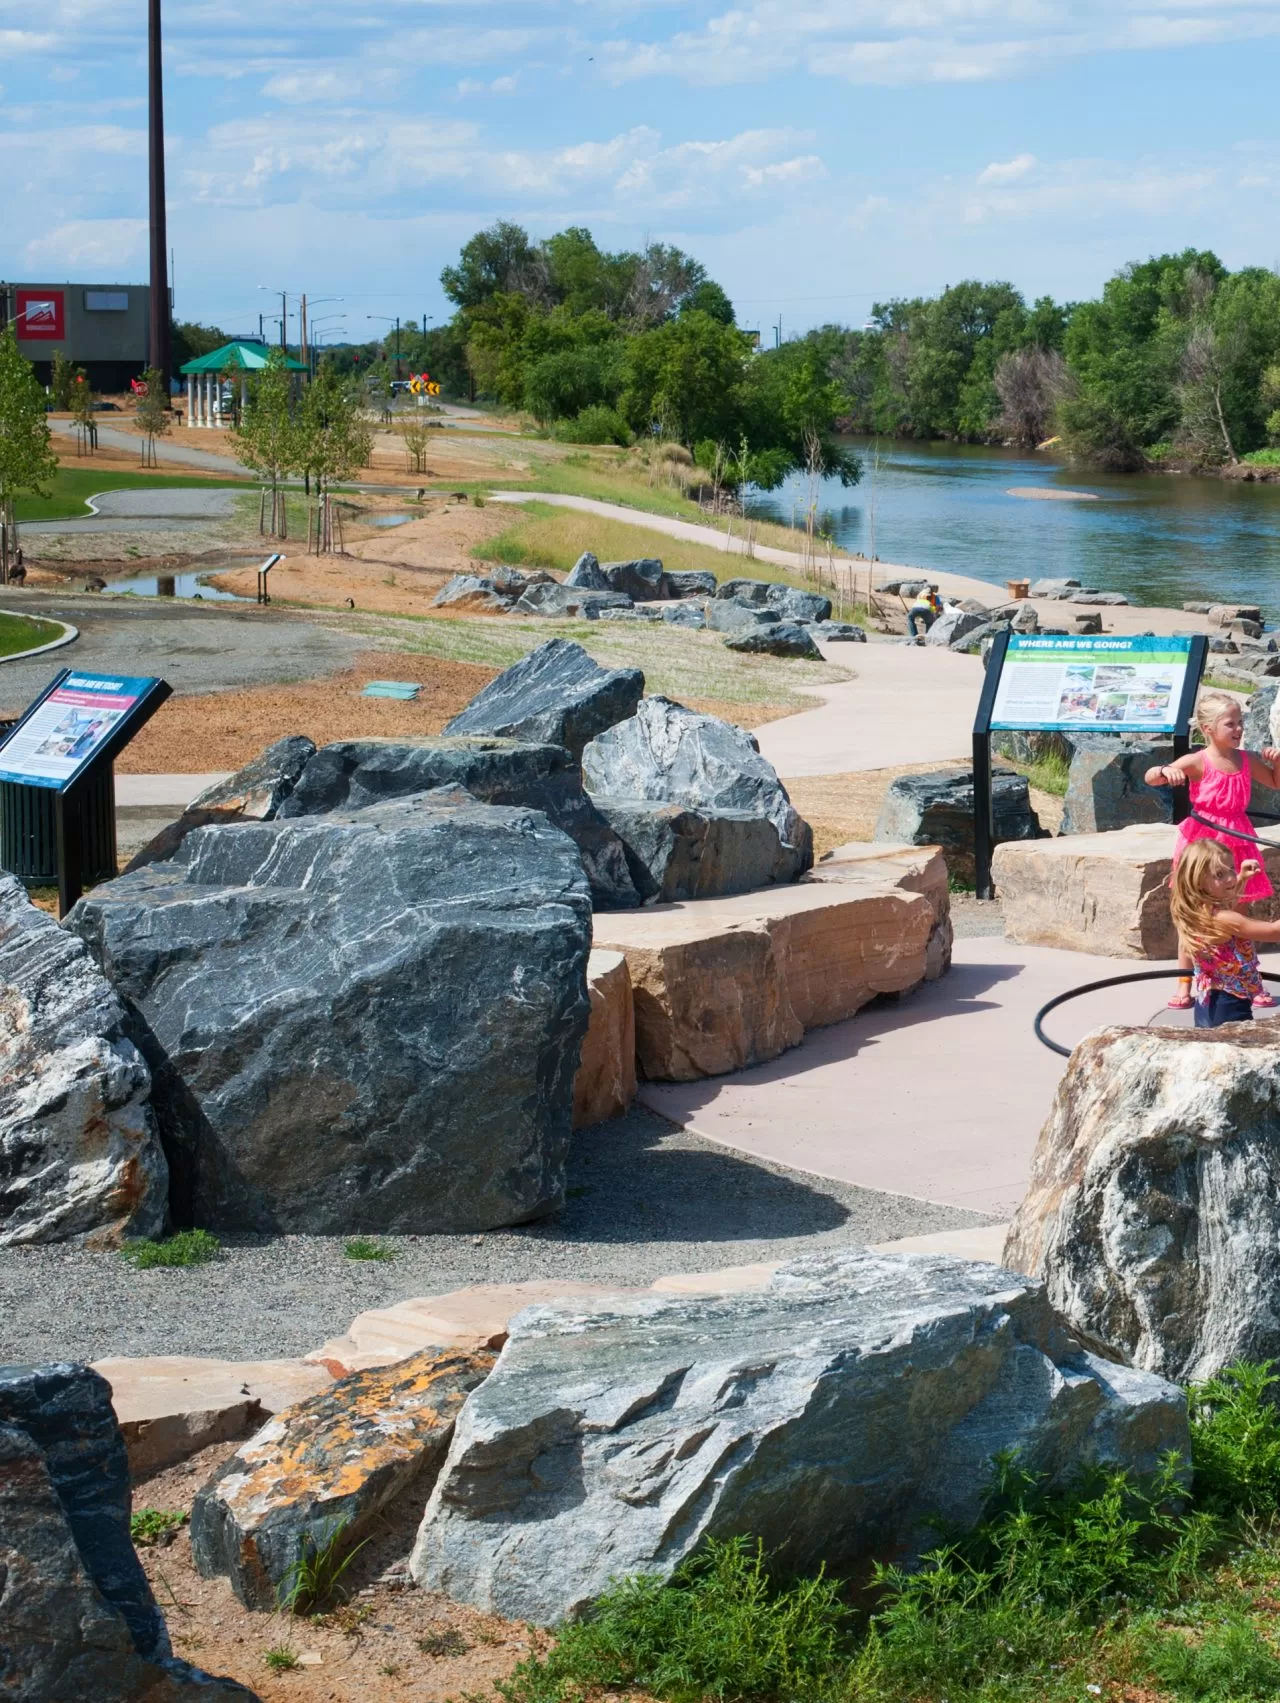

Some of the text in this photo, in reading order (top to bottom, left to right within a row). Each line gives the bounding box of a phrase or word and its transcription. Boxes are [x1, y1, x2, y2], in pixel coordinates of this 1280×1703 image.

[1018, 640, 1054, 648] WHERE
[1076, 641, 1092, 649] WE
[1094, 641, 1132, 649] GOING?
